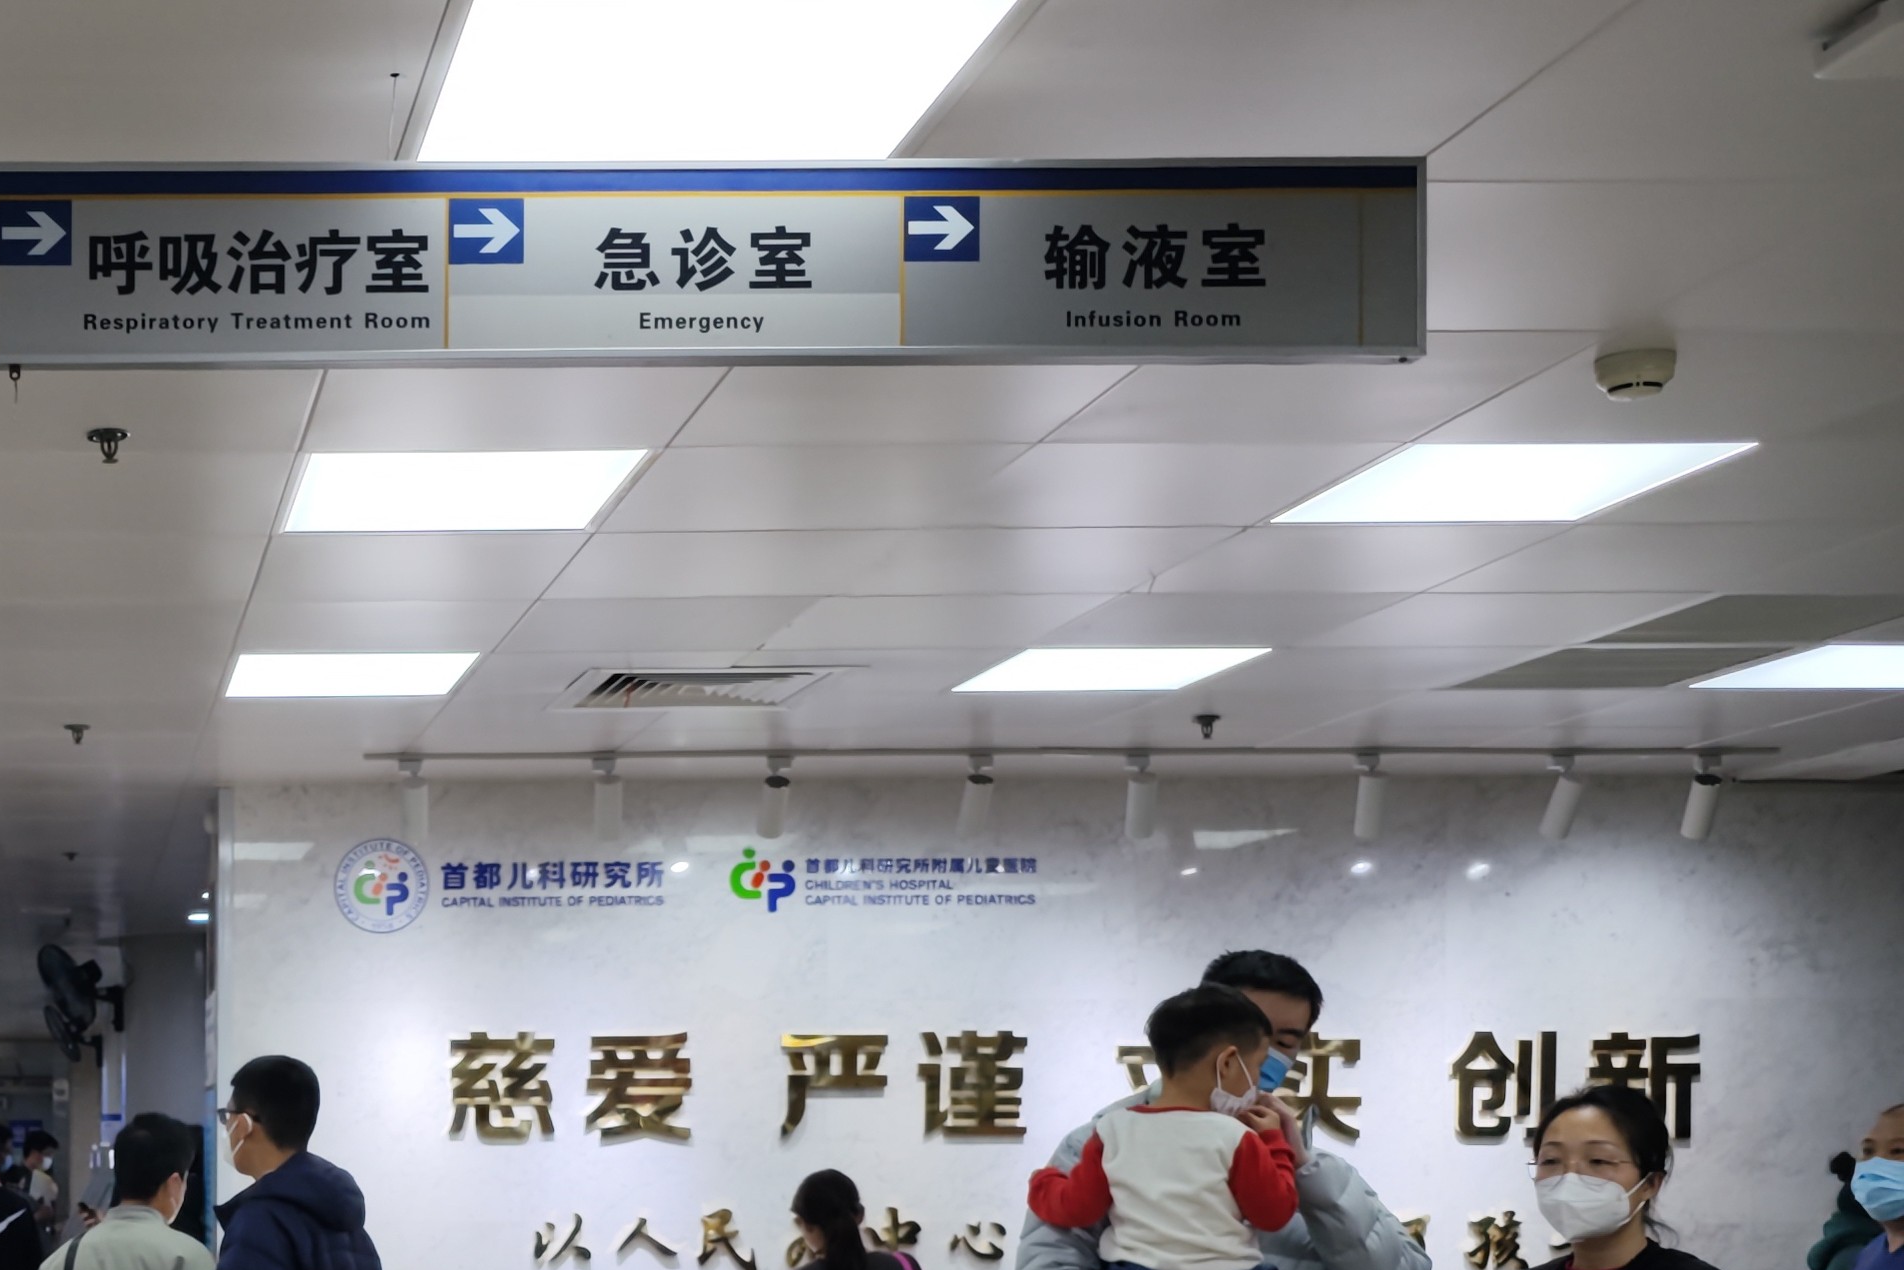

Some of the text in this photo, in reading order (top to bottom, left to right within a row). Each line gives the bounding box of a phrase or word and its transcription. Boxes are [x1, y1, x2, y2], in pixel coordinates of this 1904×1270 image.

[87, 229, 431, 296] 呼吸治疗室
[594, 225, 813, 291] 急诊室
[1043, 223, 1268, 290] 输液室
[83, 311, 432, 335] Respiratory Treatment Room
[639, 310, 765, 334] Emergency
[1065, 309, 1242, 329] Infusion Room
[440, 861, 665, 891] 首都儿科研究所
[804, 857, 1038, 875] 首都儿科研究所附属儿童医院
[804, 879, 954, 891] CHILDREN'S HOSPITAL
[441, 895, 665, 908] CAPITAL INSTITUTE OF PEDIATRICS
[804, 894, 1037, 907] CAPITAL INSTITUTE OF PEDIATRICS
[449, 1031, 693, 1142] 慈爱
[780, 1030, 1028, 1141] 严谨
